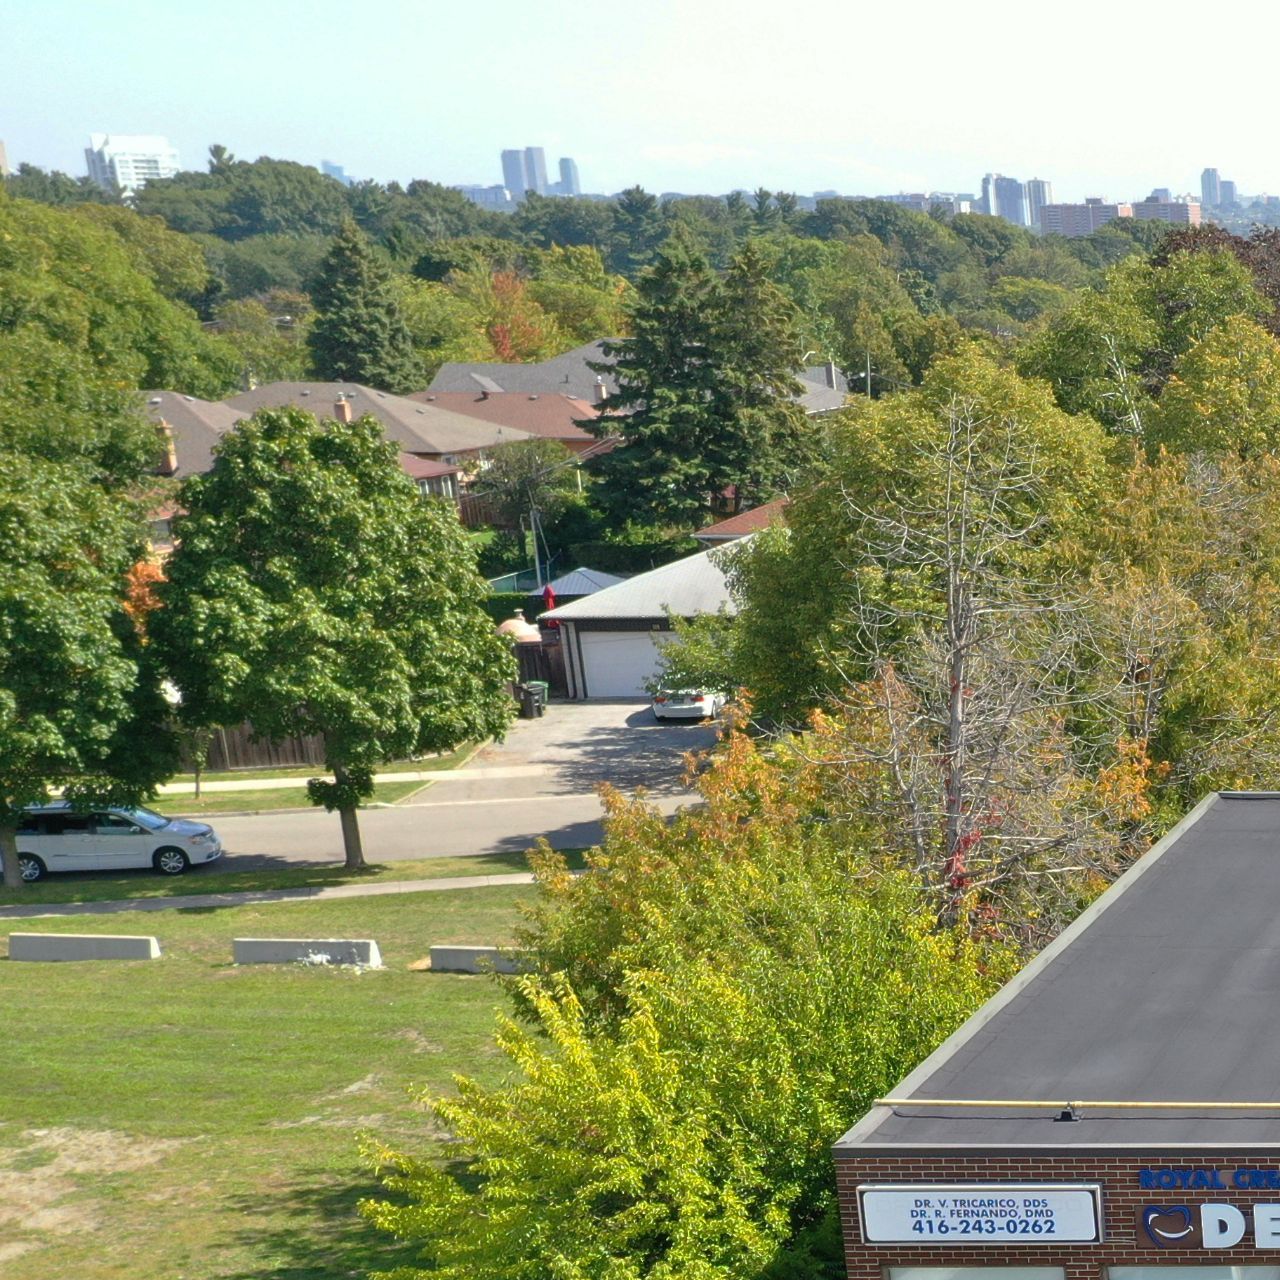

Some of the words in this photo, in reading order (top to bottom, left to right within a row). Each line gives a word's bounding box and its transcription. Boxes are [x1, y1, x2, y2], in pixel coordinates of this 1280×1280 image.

[1138, 1168, 1225, 1189] ROYAL
[914, 1199, 934, 1208] DR.
[938, 1199, 949, 1208] V.
[953, 1199, 1020, 1210] TRICARICO,
[1023, 1199, 1048, 1208] DDS
[910, 1209, 931, 1218] DR.
[935, 1209, 946, 1218] R.
[950, 1209, 1022, 1220] FERNANDO,
[1025, 1209, 1054, 1218] DMD
[911, 1219, 1056, 1235] 416-243-0262
